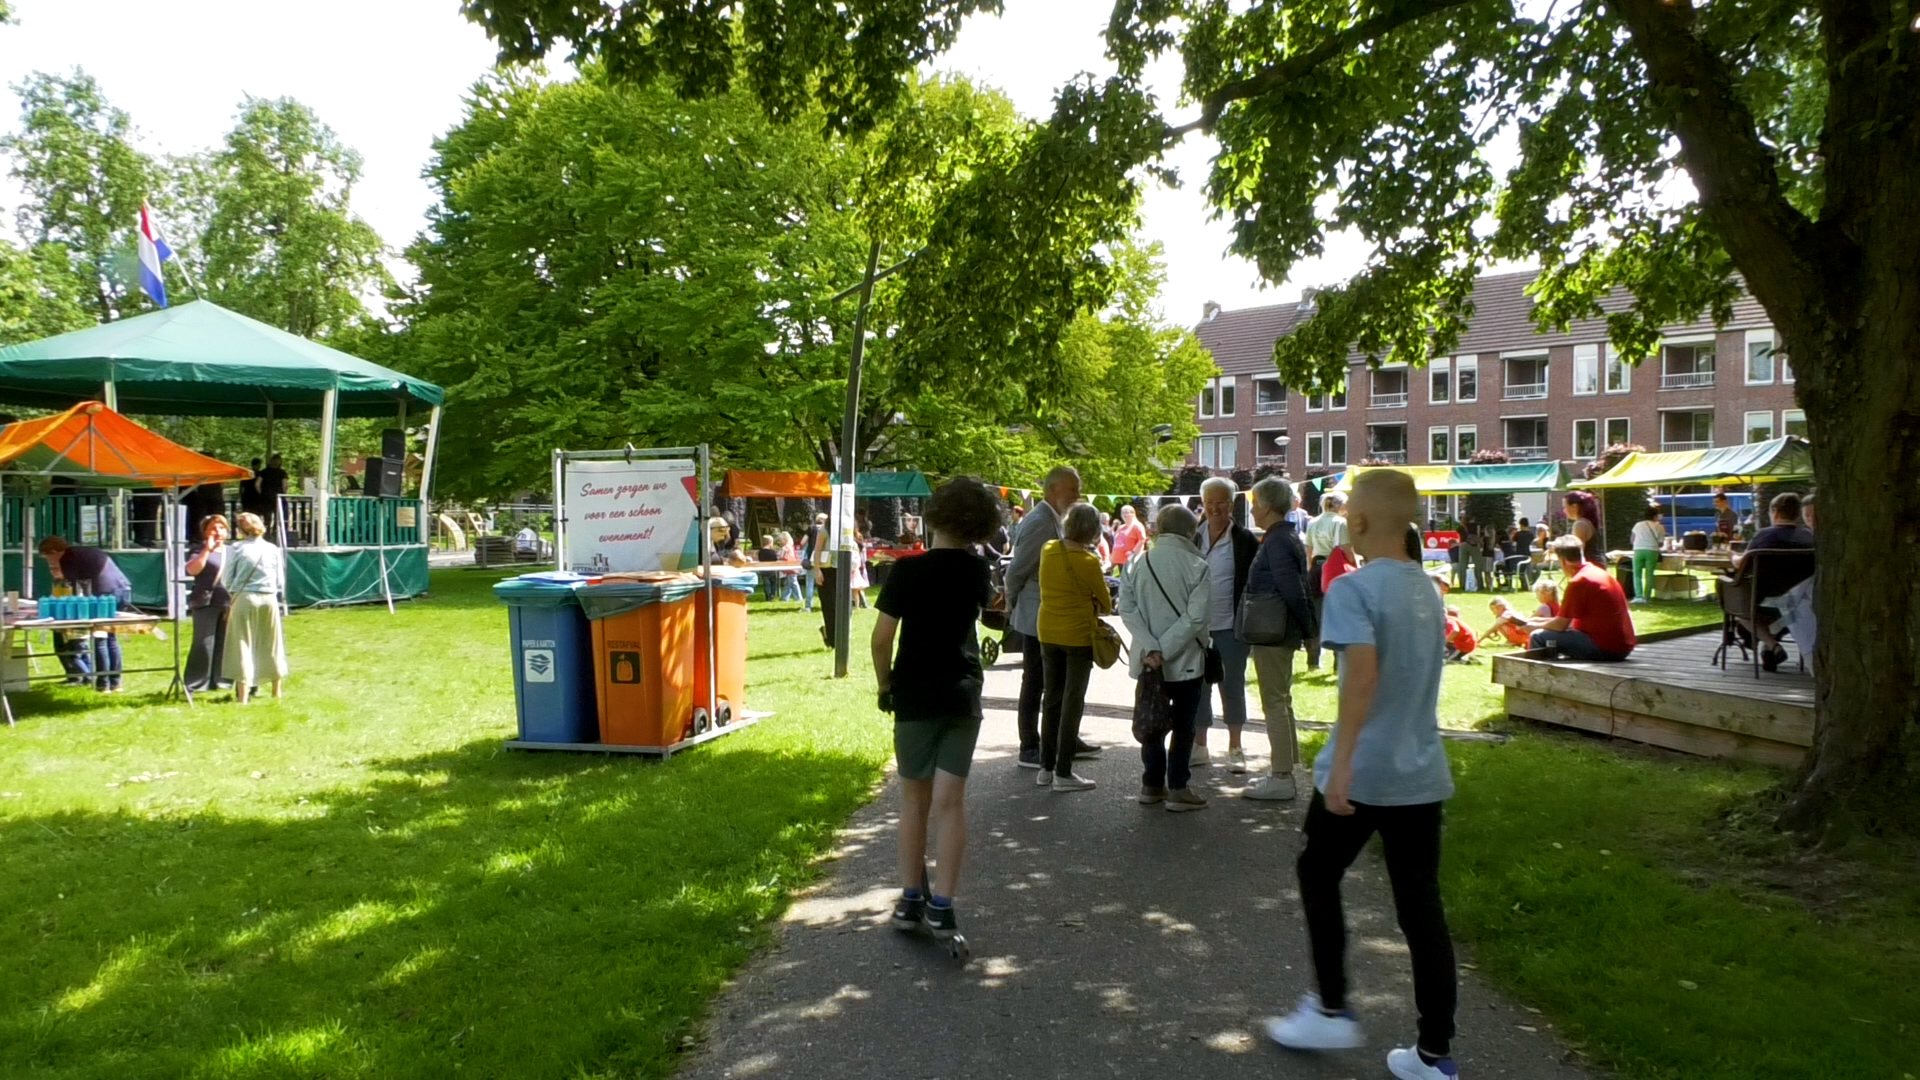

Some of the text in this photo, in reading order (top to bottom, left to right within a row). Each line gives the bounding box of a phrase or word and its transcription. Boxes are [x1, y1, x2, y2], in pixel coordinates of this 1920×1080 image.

[580, 482, 668, 500] Samen zorgen we
[584, 503, 663, 520] voor een schoon
[598, 525, 655, 543] evenement!
